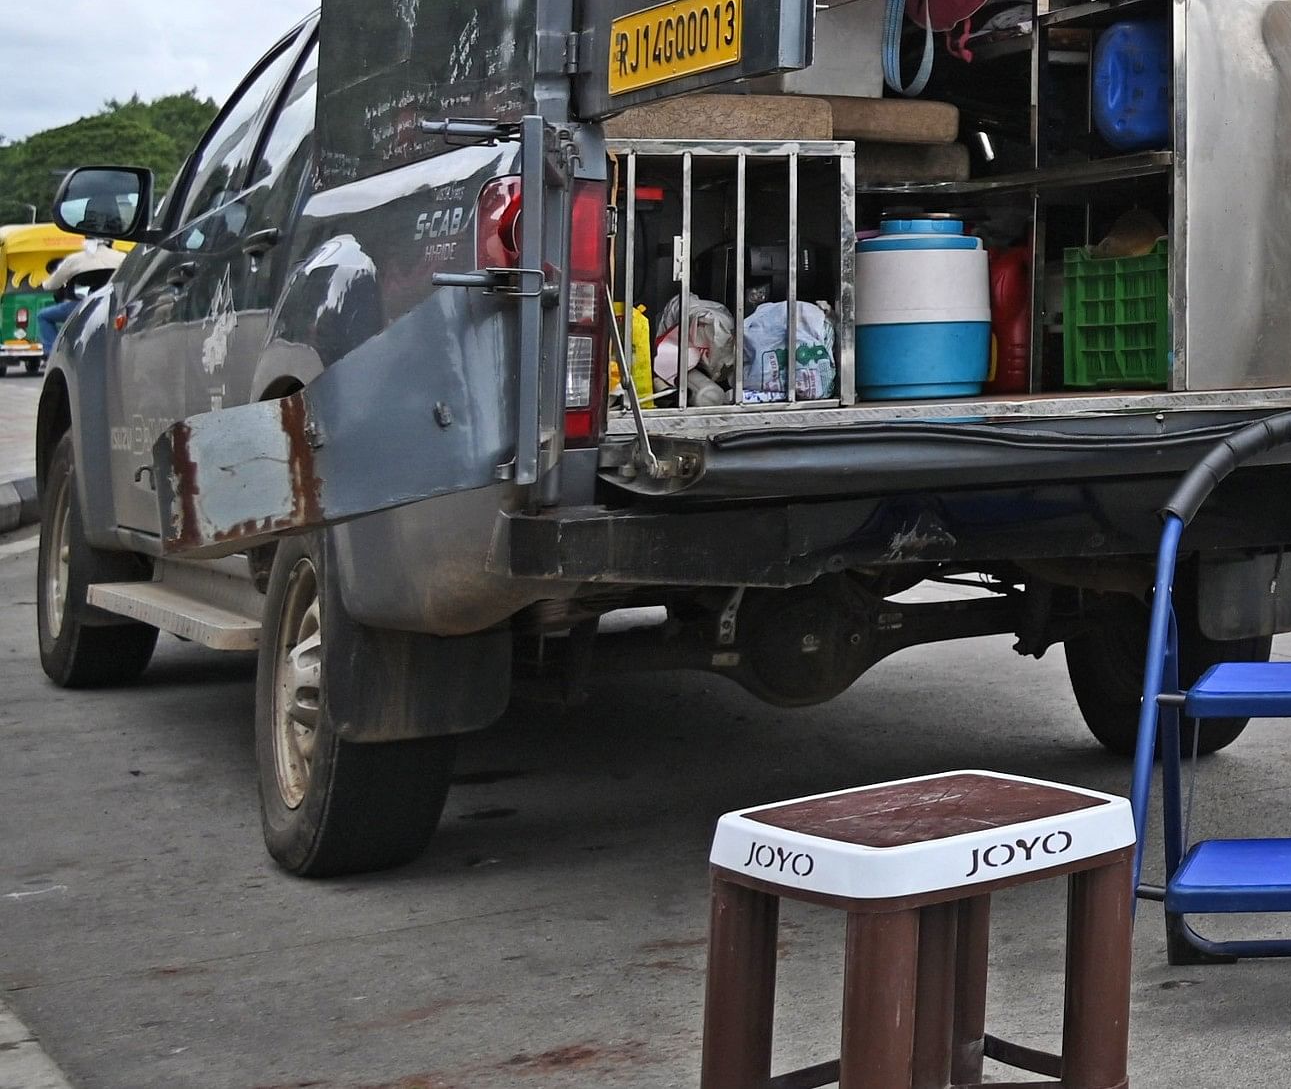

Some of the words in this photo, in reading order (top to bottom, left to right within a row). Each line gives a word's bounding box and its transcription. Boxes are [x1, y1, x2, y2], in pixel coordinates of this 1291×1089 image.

[619, 0, 736, 78] RJ14GQ0013
[414, 207, 463, 241] S-CAB
[744, 841, 815, 877] JOYO
[965, 830, 1073, 877] JOYO
